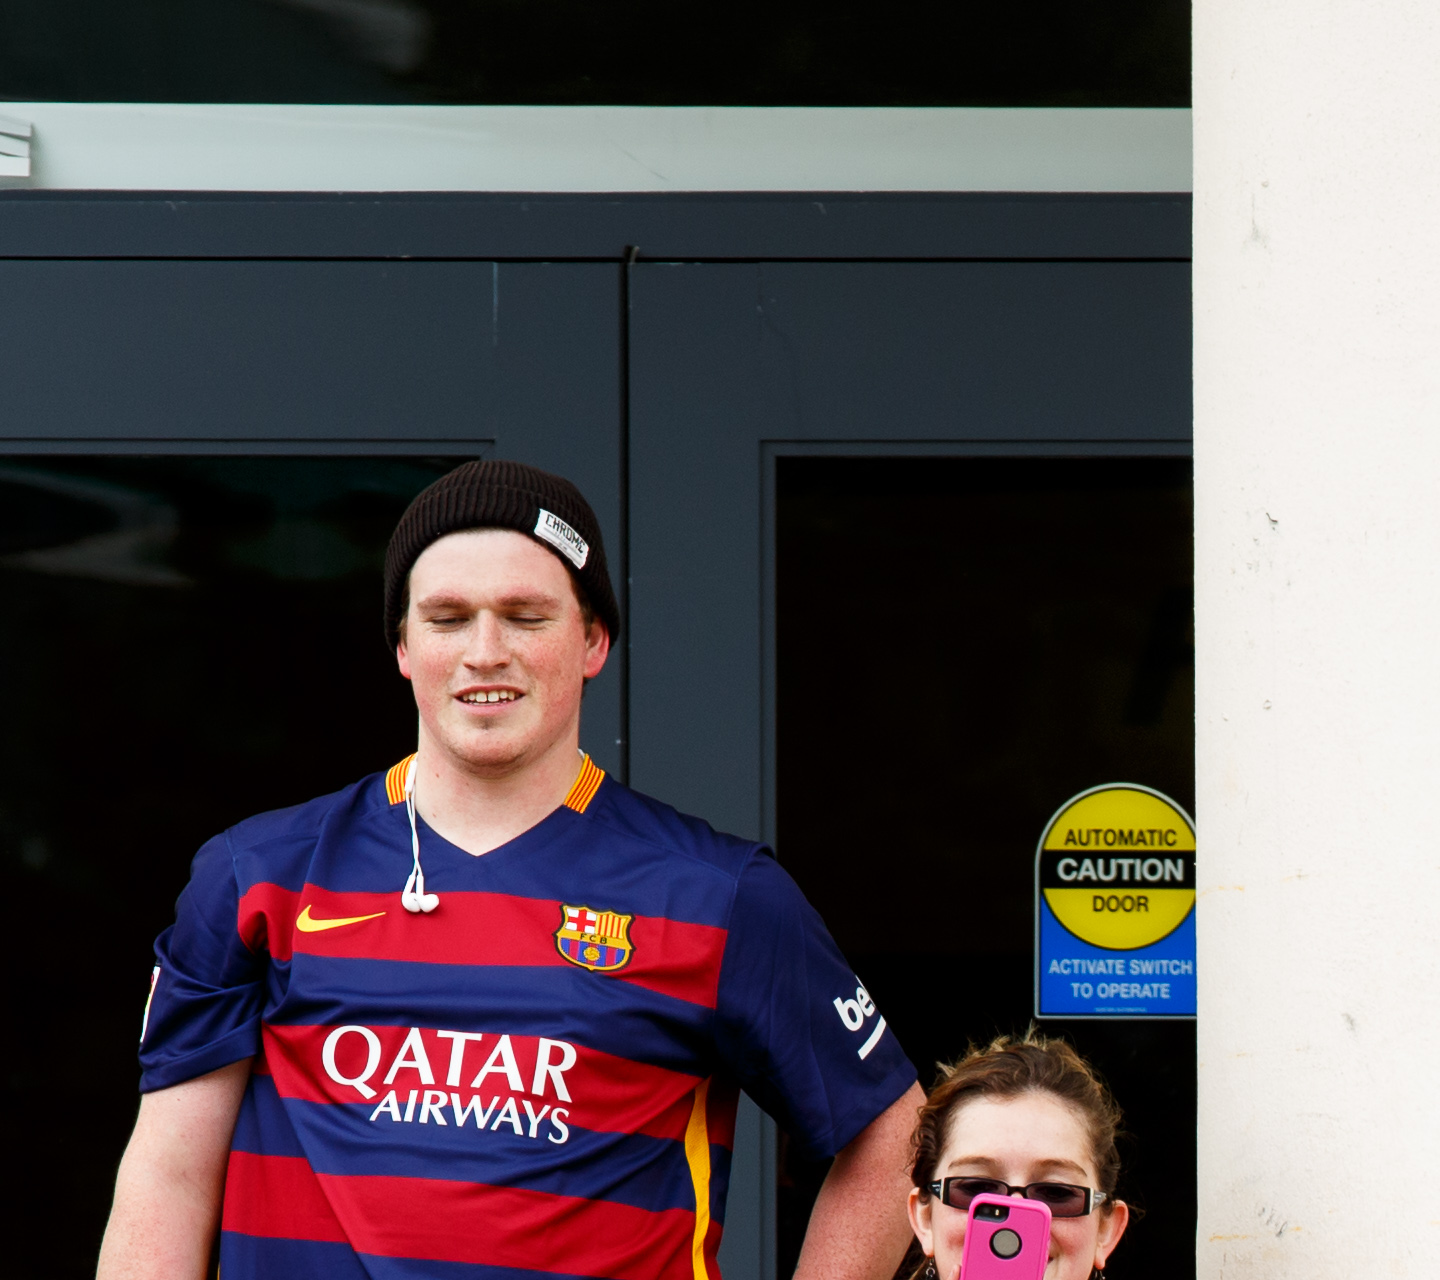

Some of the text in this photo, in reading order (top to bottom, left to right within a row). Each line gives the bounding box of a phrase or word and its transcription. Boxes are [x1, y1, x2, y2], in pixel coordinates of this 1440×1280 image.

[545, 514, 586, 553] CHROME
[1064, 828, 1177, 846] AUTOMATIC
[1057, 858, 1184, 881] CAUTION
[1092, 895, 1149, 912] DOOR
[1048, 958, 1193, 976] ACTIVATE SWITCH
[1070, 982, 1171, 999] TO OPERATE
[322, 1025, 577, 1103] QATAR
[369, 1089, 570, 1144] AIRWAYS
